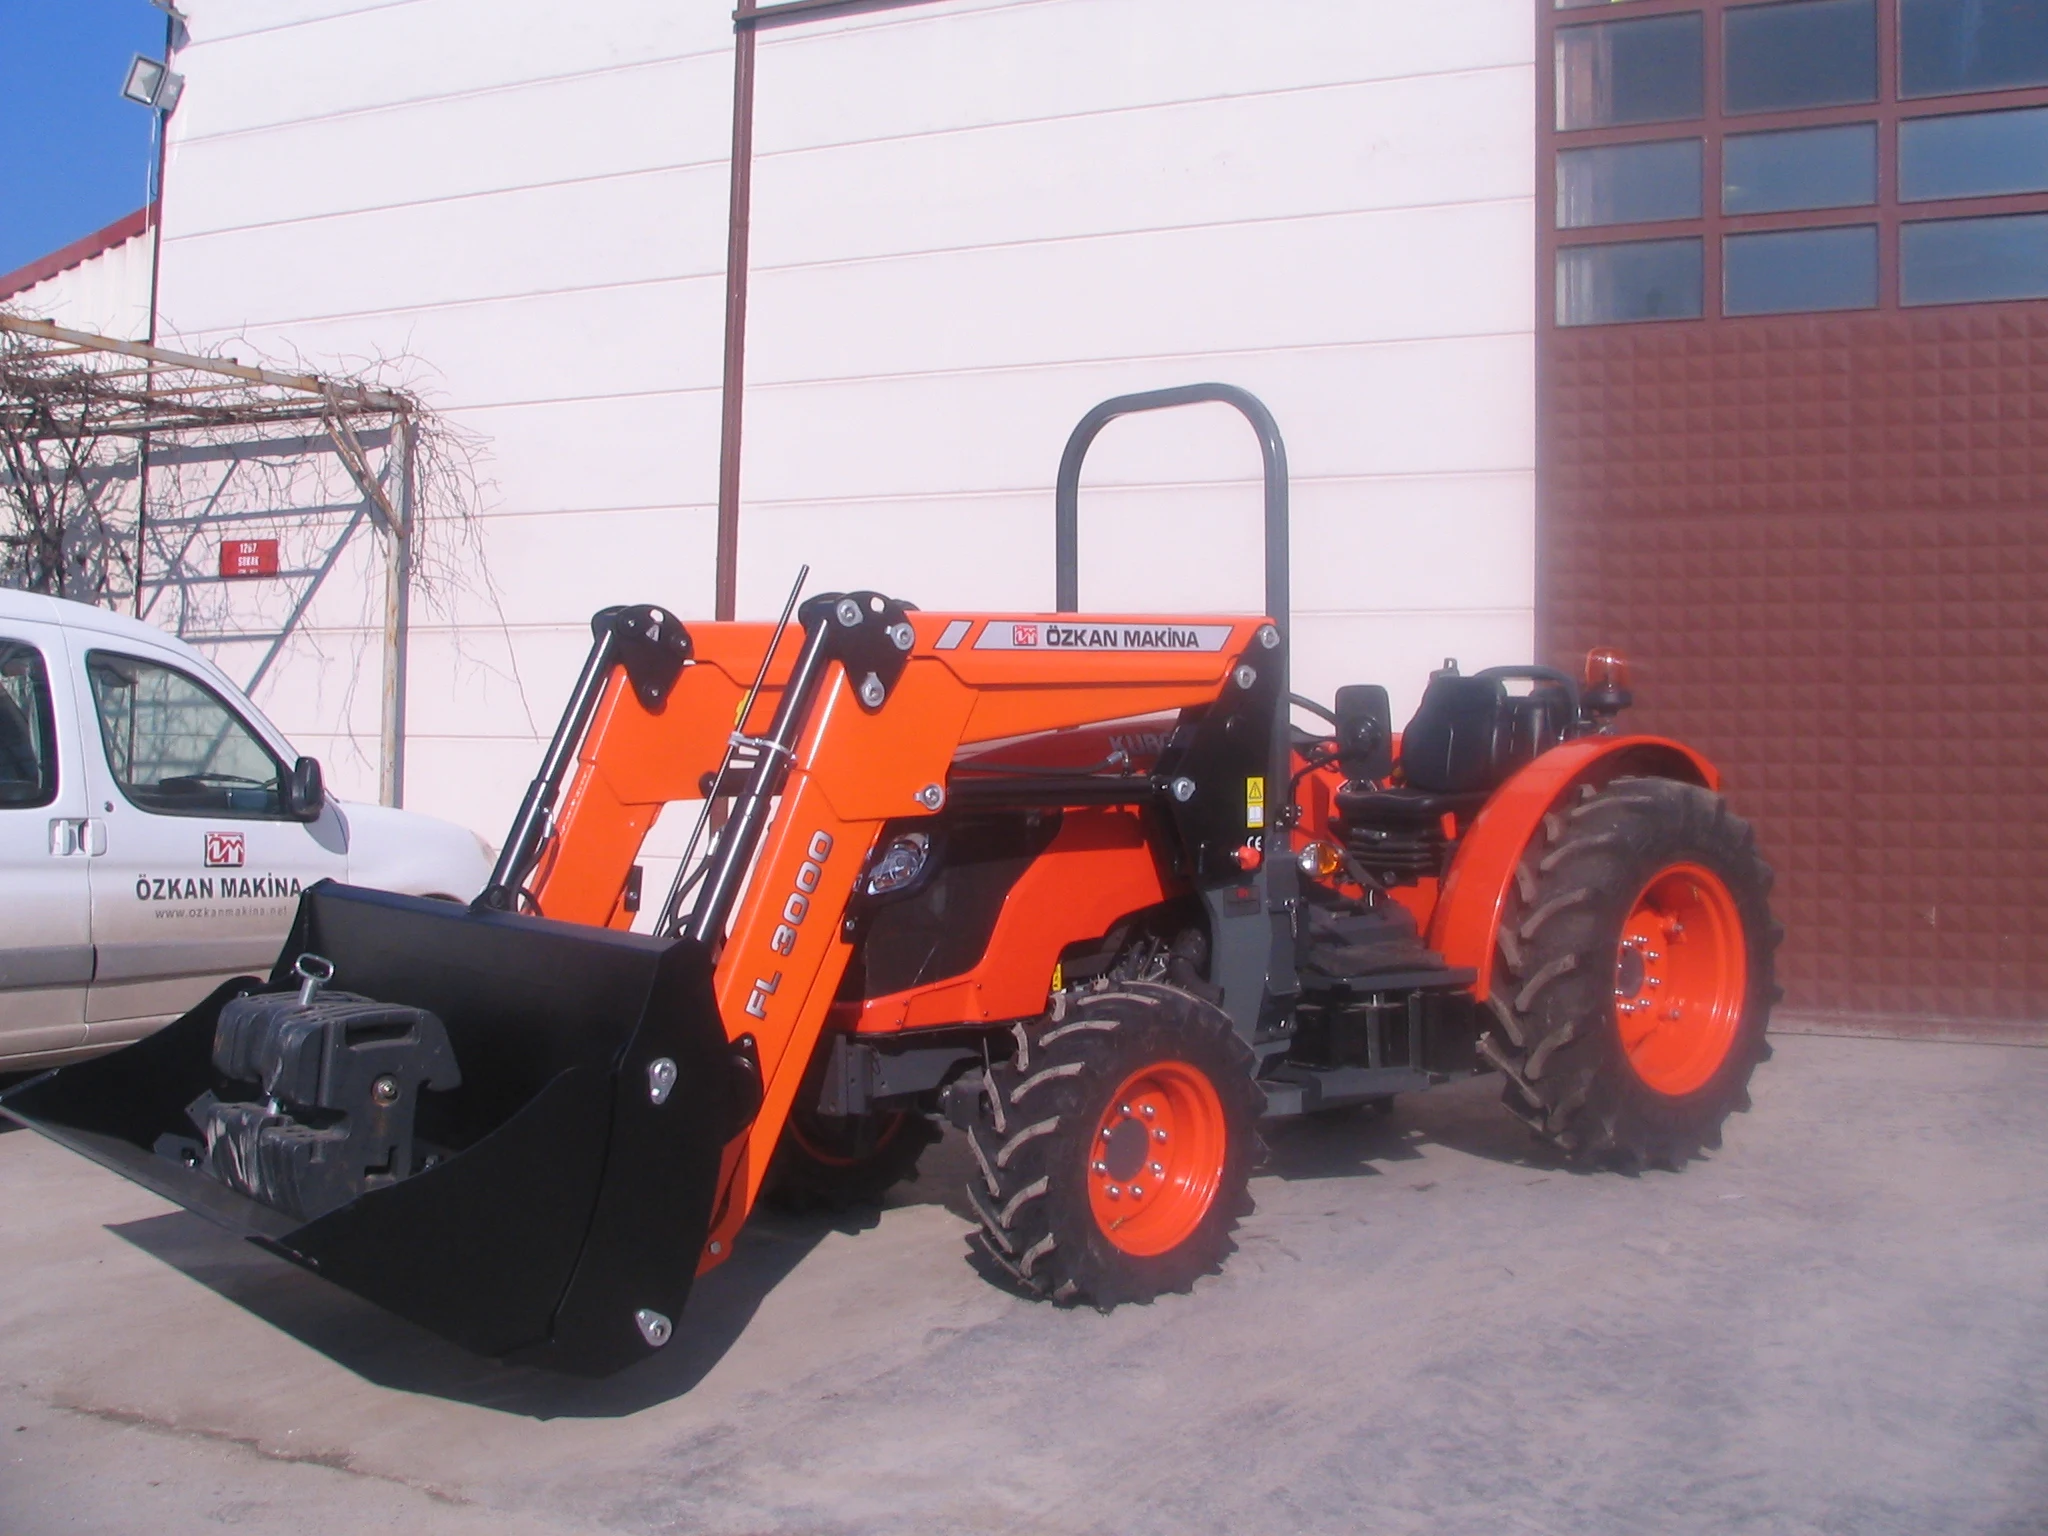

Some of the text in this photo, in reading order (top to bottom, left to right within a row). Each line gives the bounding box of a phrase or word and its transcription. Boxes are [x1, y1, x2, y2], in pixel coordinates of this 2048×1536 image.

[1046, 625, 1200, 648] ÖZKAN MAKİNA
[136, 872, 301, 901] ÖZKAN MAKİNA
[155, 905, 288, 919] www.ozkanmakina.net
[744, 829, 834, 1021] FL 3000
